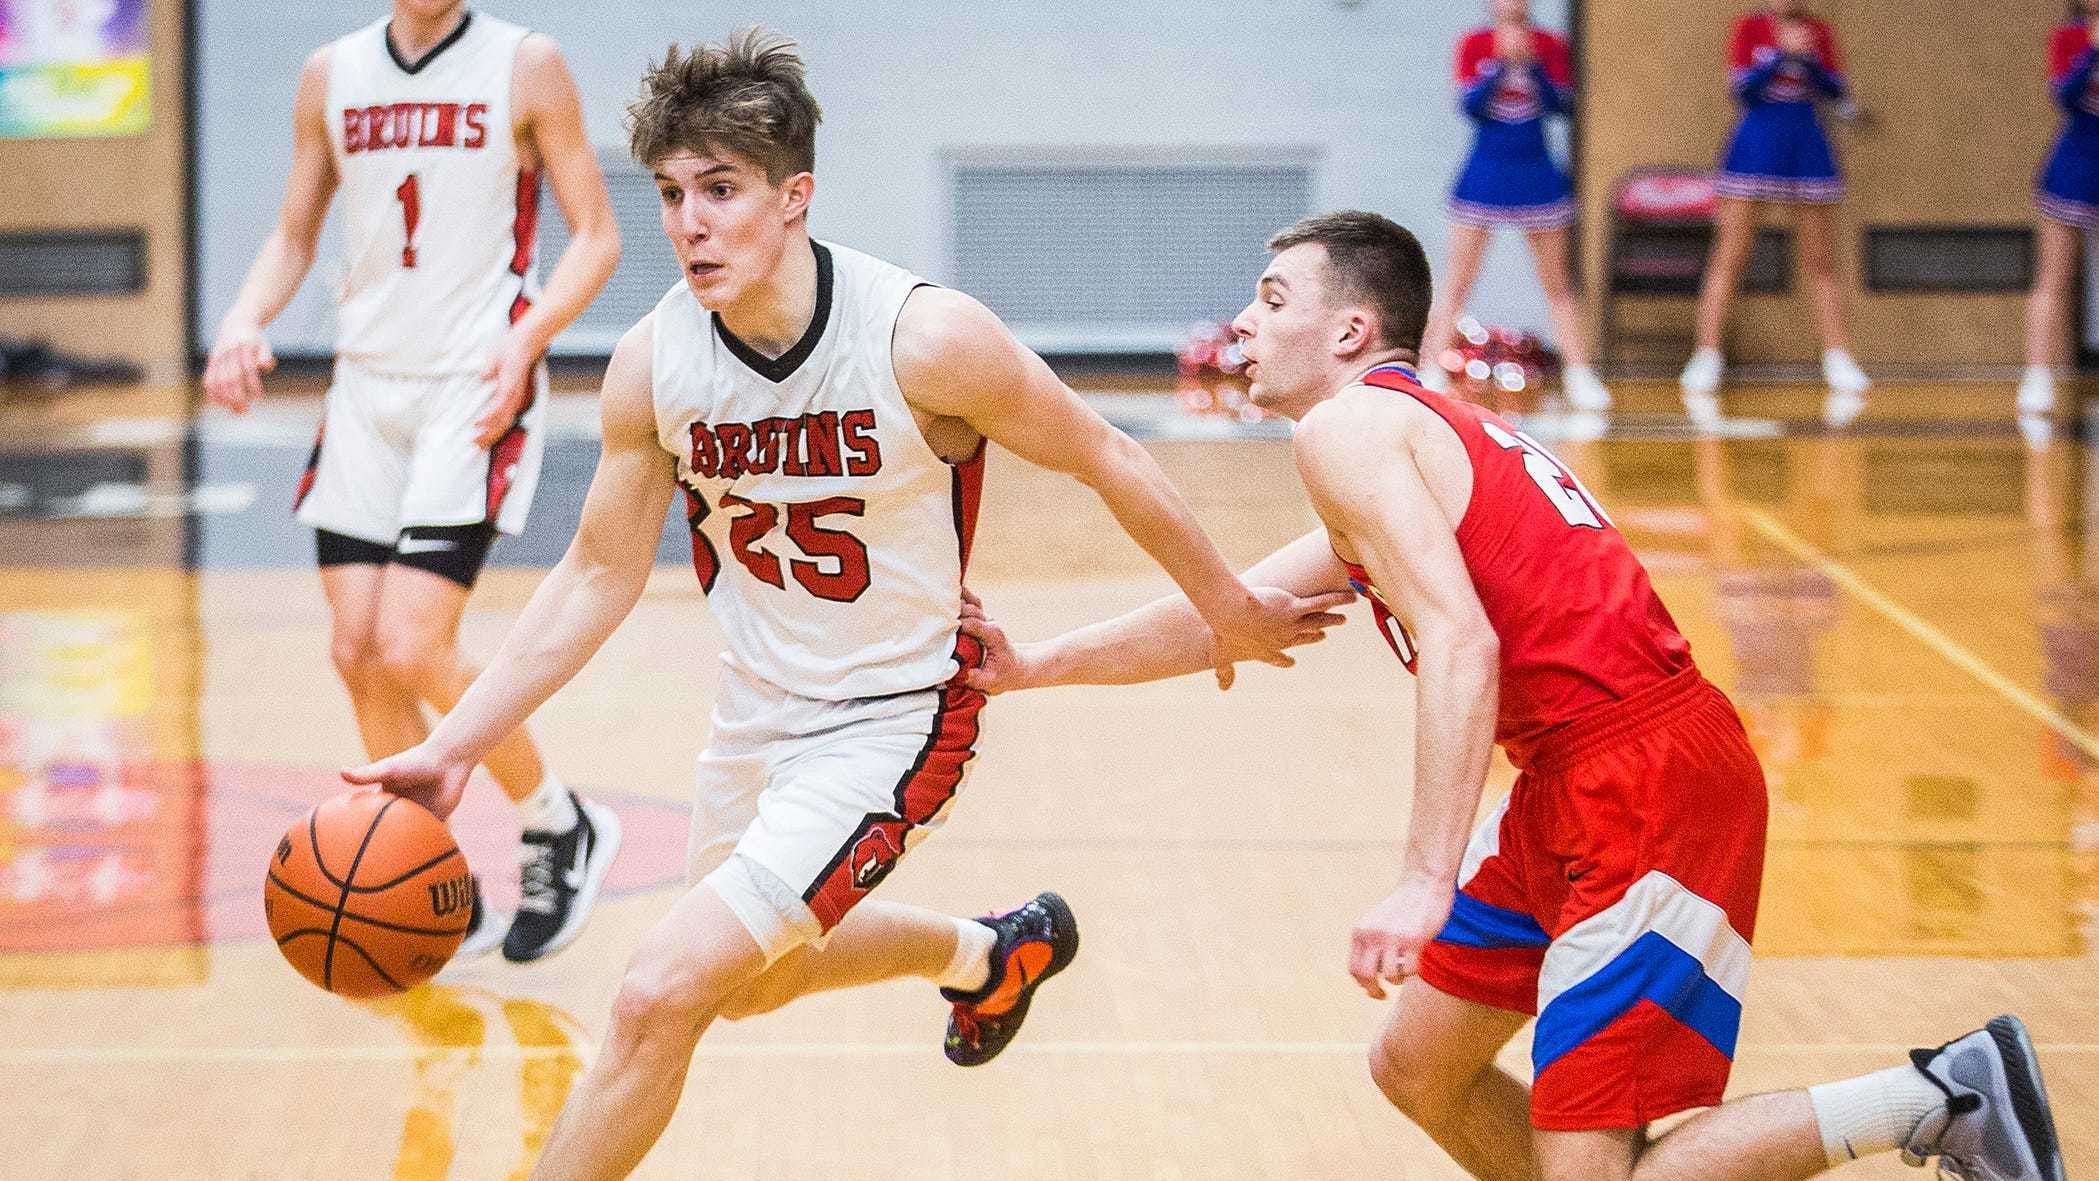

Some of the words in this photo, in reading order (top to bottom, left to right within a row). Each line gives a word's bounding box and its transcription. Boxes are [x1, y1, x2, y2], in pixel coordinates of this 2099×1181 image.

[395, 174, 421, 268] 1
[689, 408, 883, 480] BRUINS
[718, 496, 872, 603] 25
